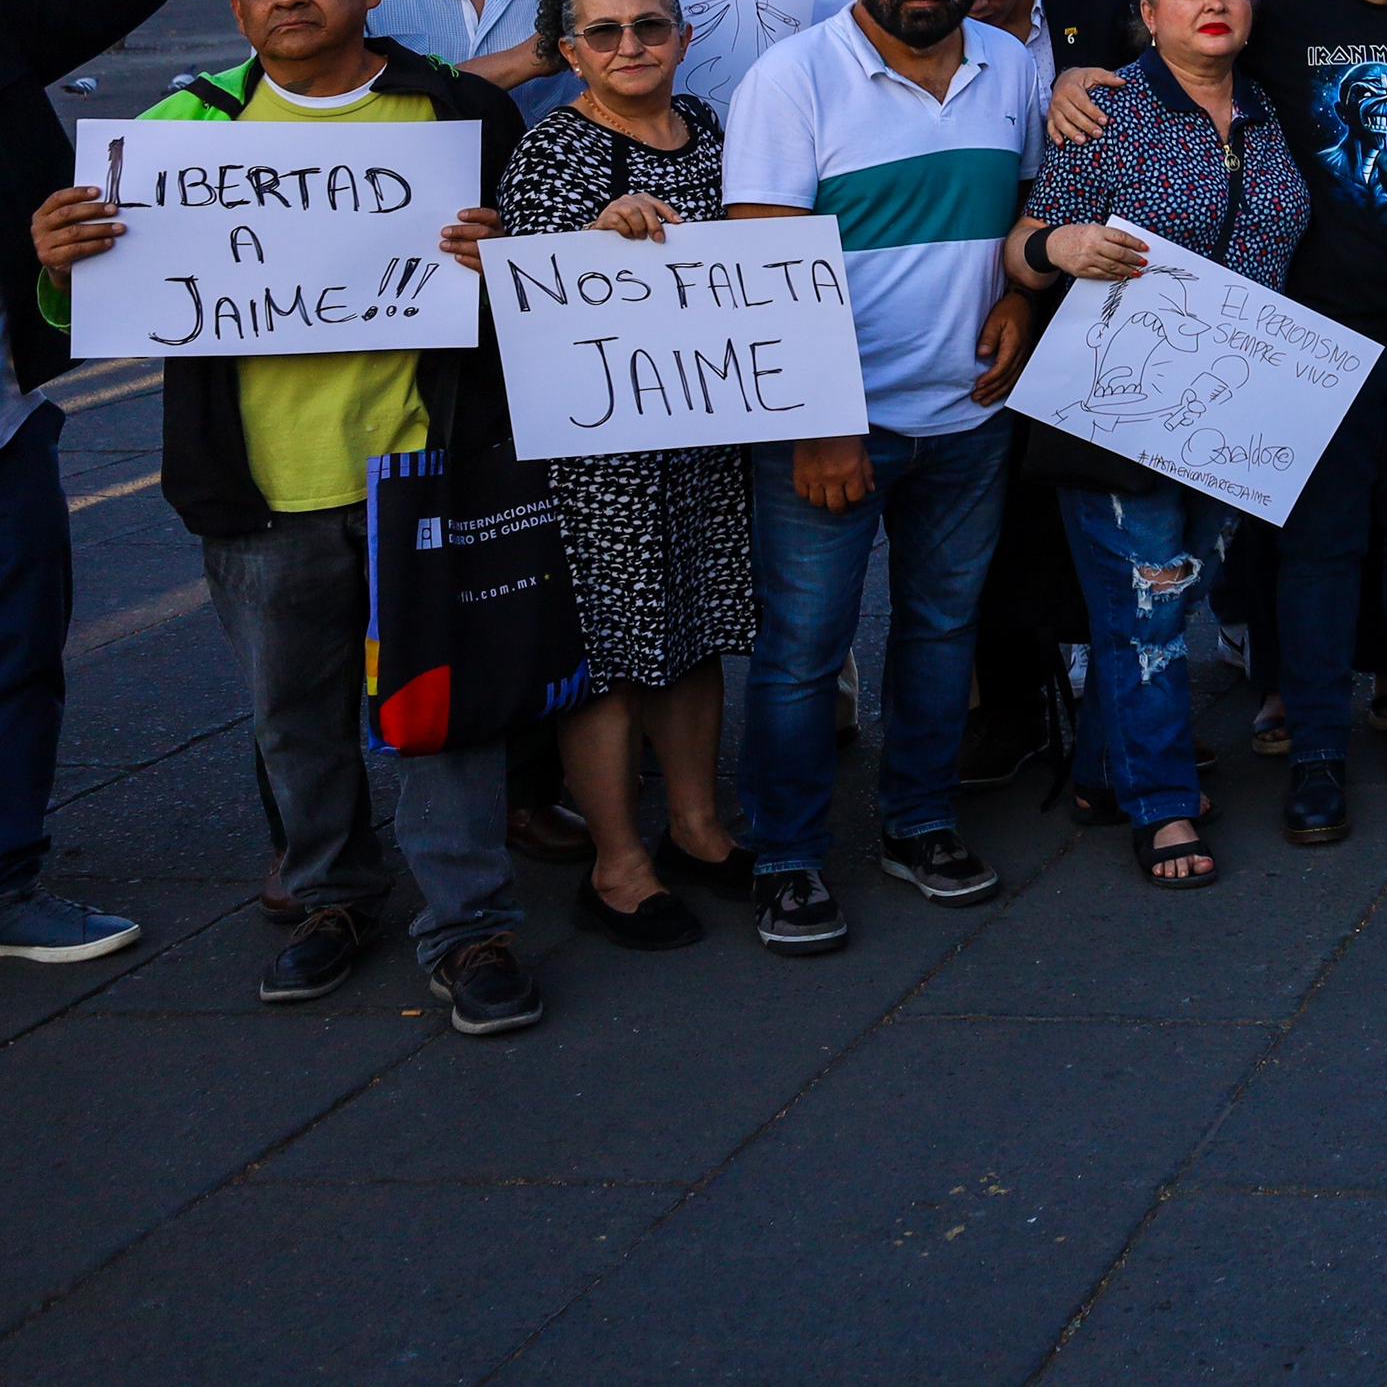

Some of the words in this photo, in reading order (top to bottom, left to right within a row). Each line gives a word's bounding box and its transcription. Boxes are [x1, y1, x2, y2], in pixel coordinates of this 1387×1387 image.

[1307, 45, 1367, 66] IRON
[105, 136, 413, 214] LIBERTAD
[230, 225, 264, 264] A
[665, 259, 846, 310] FALTA
[1213, 323, 1287, 367] SIEMPRE
[1295, 361, 1339, 389] VIVO
[1220, 284, 1250, 321] EL
[1256, 304, 1361, 373] PERIODISMO
[570, 336, 806, 429] JAIME
[479, 529, 497, 542] DE
